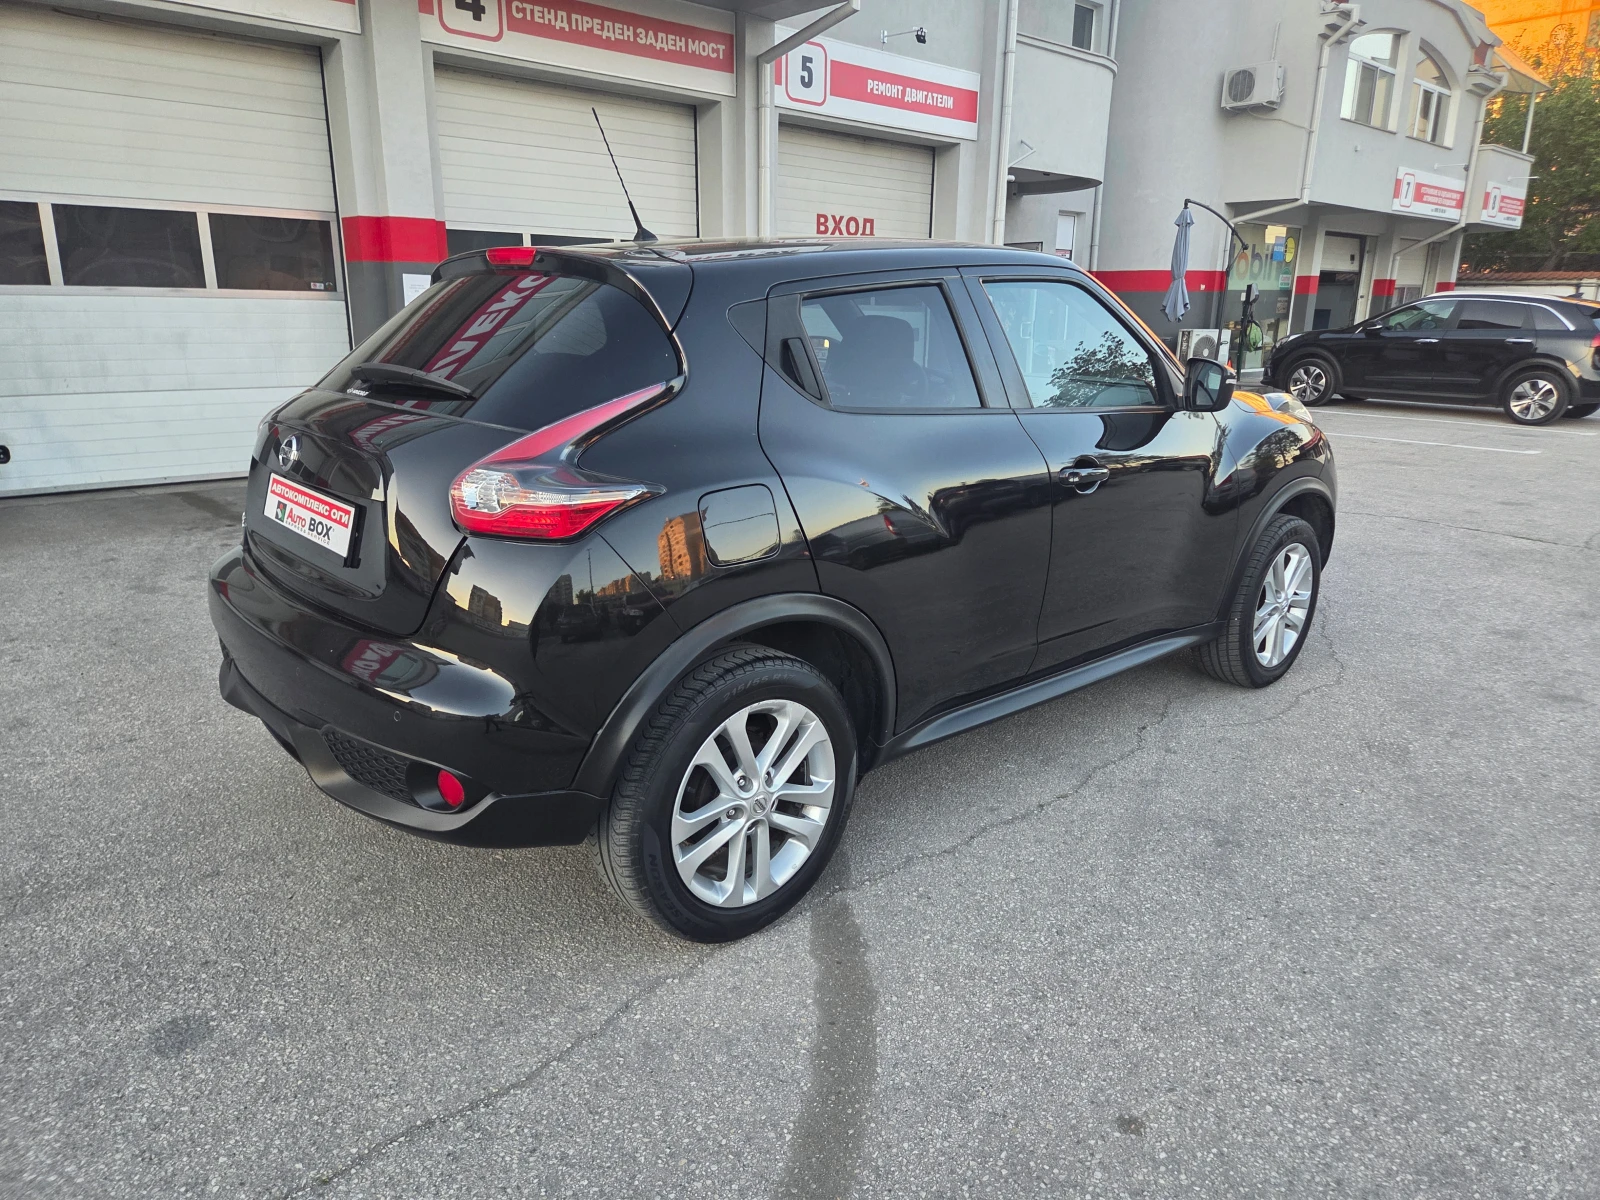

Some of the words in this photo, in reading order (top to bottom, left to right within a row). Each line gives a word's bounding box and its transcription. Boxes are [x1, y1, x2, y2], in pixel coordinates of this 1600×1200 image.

[511, 0, 569, 32] СТЕНД
[572, 14, 634, 42] ПРЕДЕН
[636, 27, 686, 52] ЗАДЕН
[688, 38, 726, 60] МОСТ
[800, 55, 814, 89] 5
[867, 79, 903, 99] РЕМОНТ
[904, 87, 954, 110] ДВИГАТЕЛИ
[1404, 181, 1411, 199] 7
[816, 213, 876, 237] ВХОД
[1230, 243, 1277, 281] obil
[272, 482, 330, 516] АВТОКОМПЛЕКС
[330, 508, 350, 525] ОГИ
[307, 531, 331, 546] SERVICE
[308, 516, 333, 541] BOX
